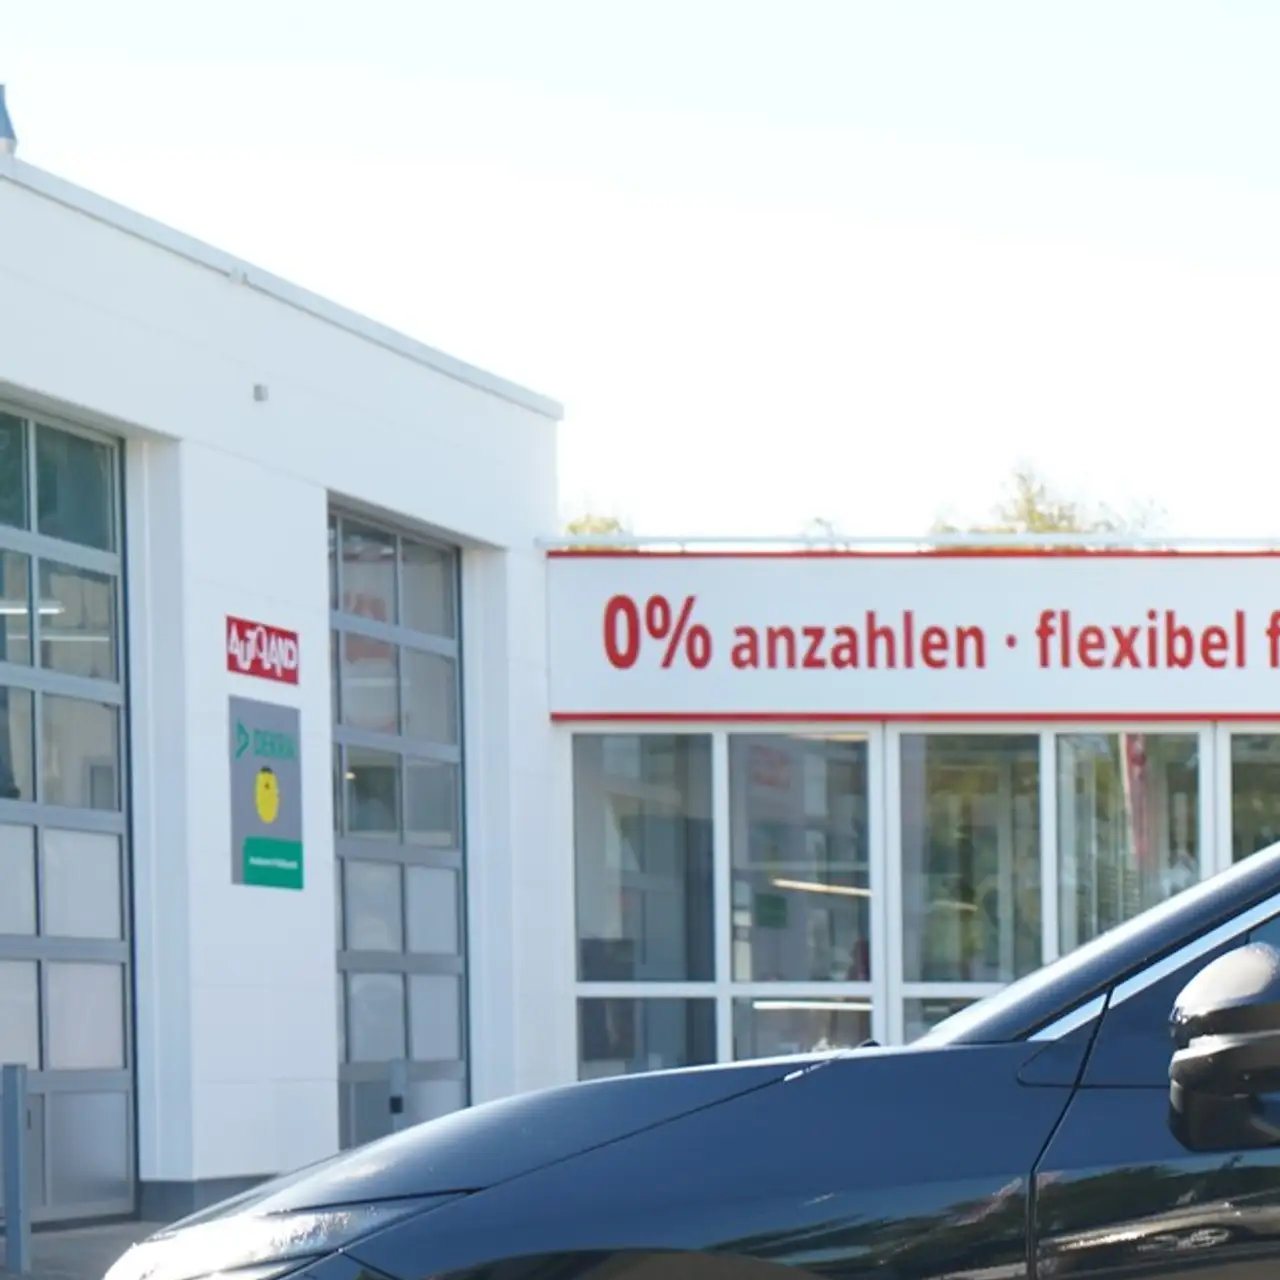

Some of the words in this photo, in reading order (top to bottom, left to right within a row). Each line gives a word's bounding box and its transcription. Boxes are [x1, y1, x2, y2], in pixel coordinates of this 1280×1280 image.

[603, 594, 712, 670] 0%
[729, 610, 986, 670] anzahlen
[1035, 609, 1247, 670] flexibel
